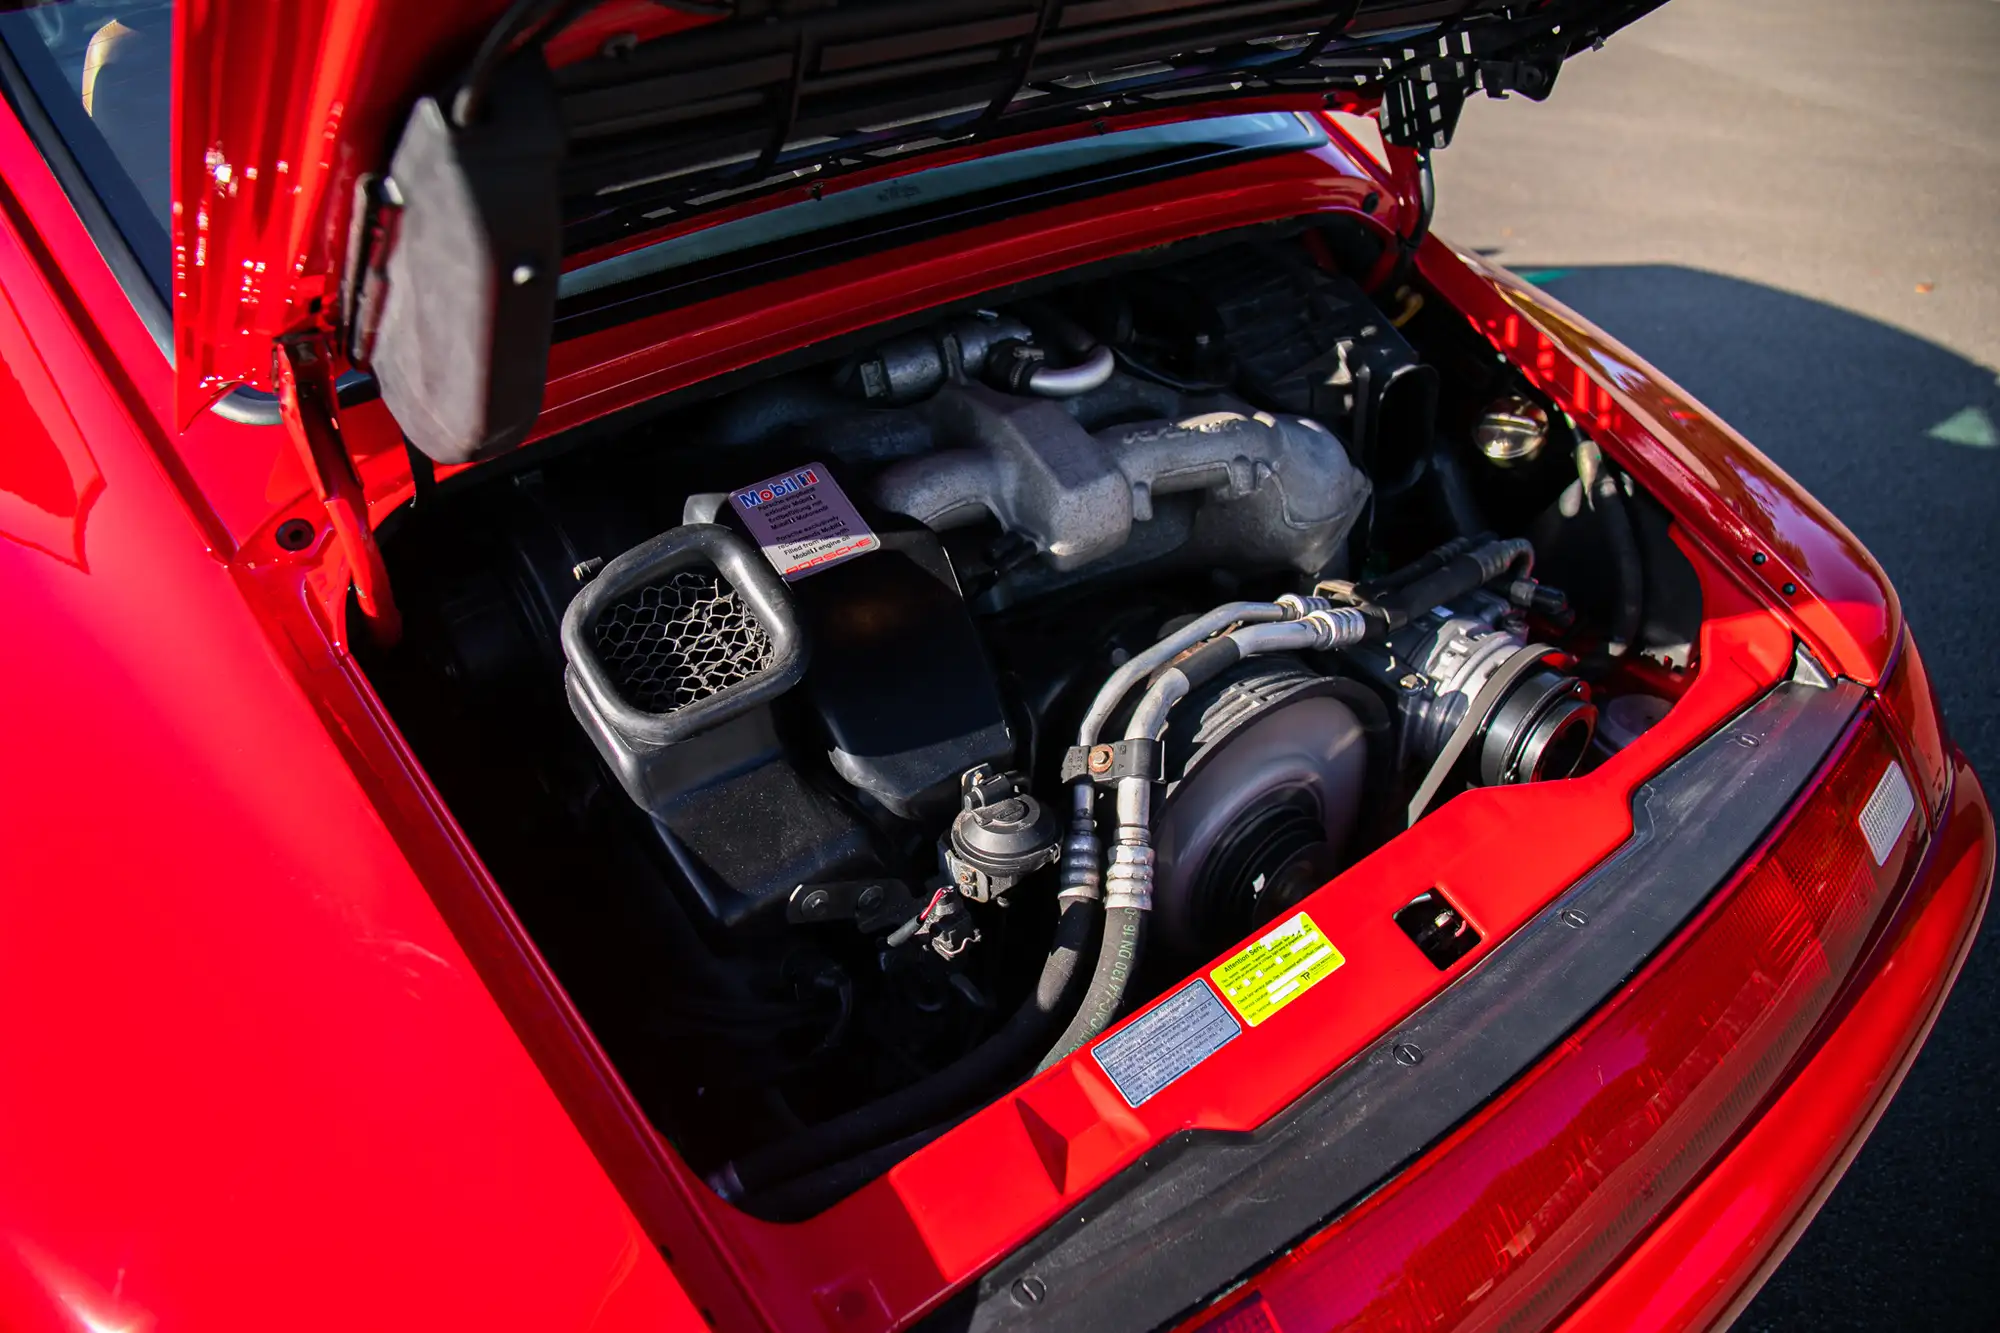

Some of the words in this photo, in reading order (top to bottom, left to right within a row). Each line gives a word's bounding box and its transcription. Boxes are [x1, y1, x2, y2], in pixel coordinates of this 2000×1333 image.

[738, 477, 799, 509] Mobil
[775, 528, 804, 542] Porsche
[817, 538, 842, 551] engine
[783, 544, 802, 555] Filled
[802, 538, 819, 548] from
[784, 537, 871, 575] PORSCHE
[1122, 923, 1136, 937] 16
[1118, 940, 1134, 960] DN
[1223, 952, 1250, 973] Attention
[1248, 942, 1265, 955] Serv
[1110, 961, 1128, 983] 130
